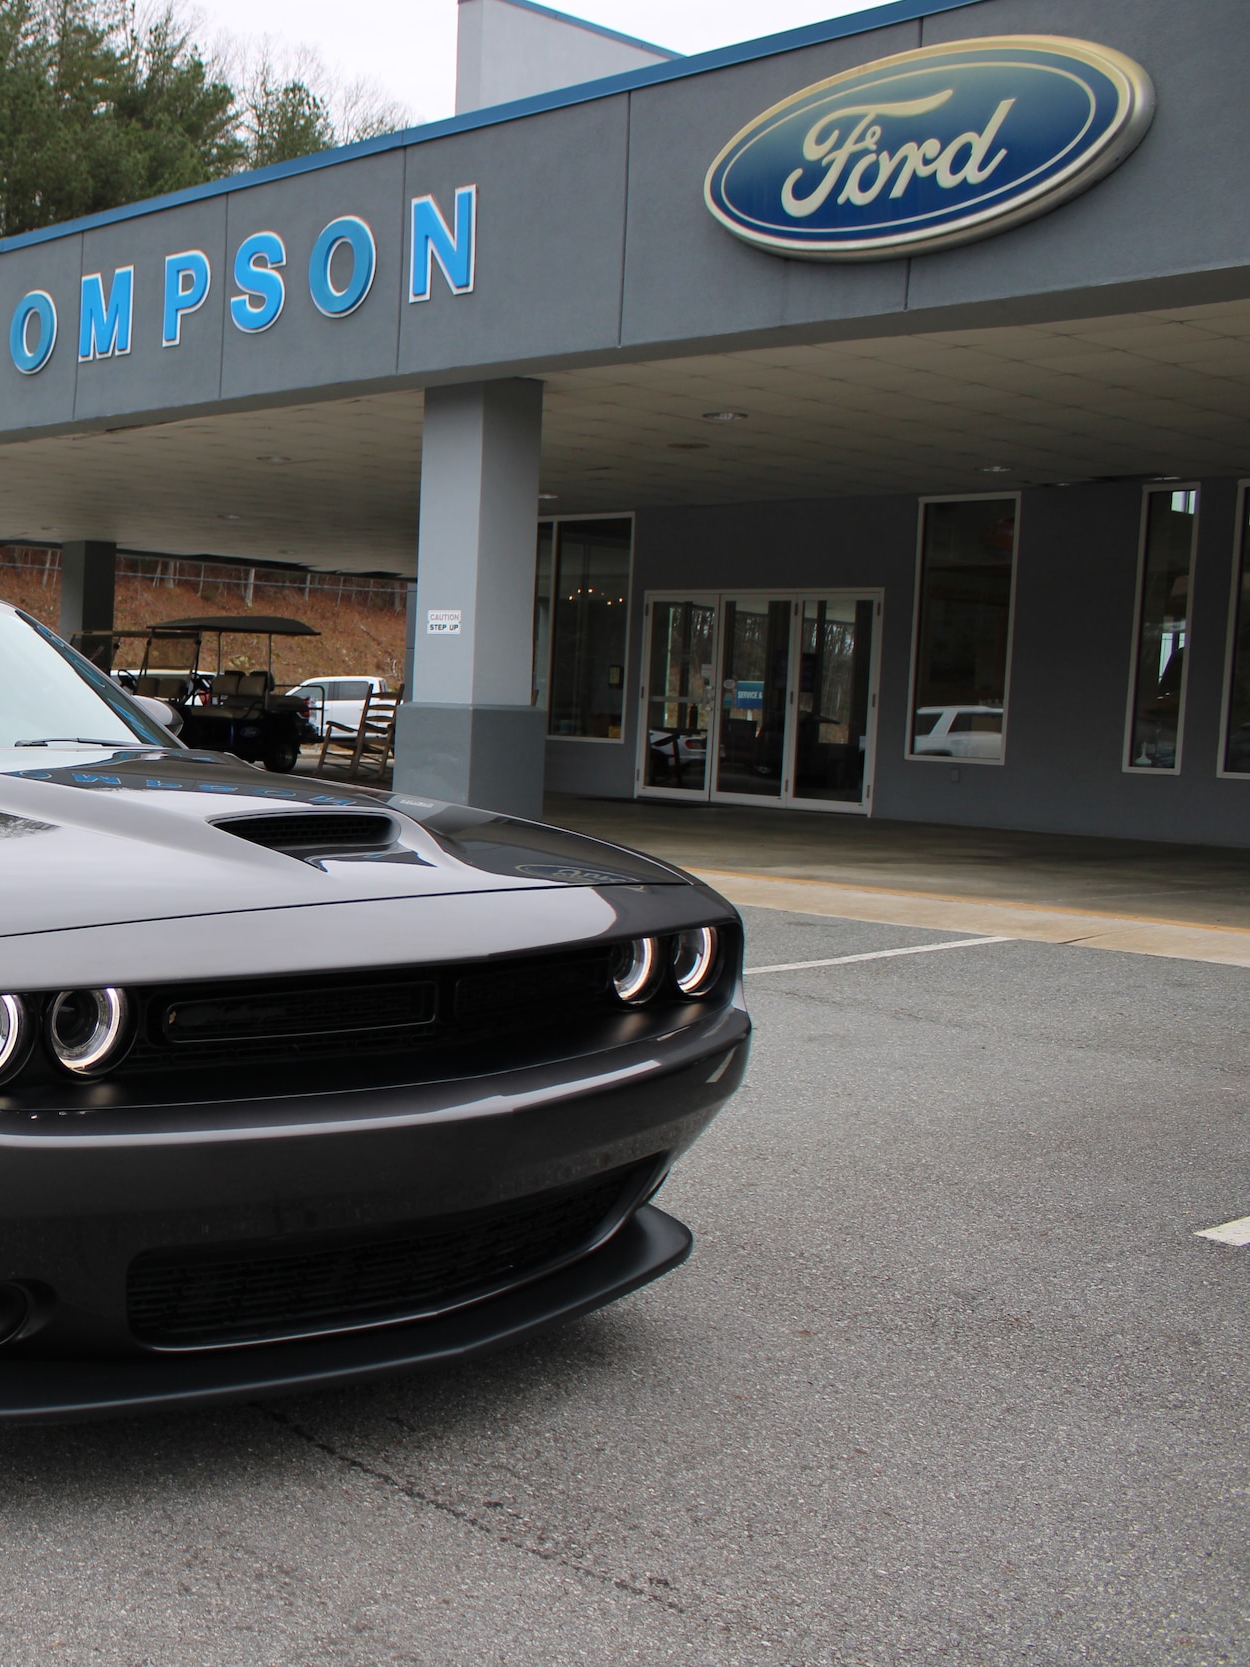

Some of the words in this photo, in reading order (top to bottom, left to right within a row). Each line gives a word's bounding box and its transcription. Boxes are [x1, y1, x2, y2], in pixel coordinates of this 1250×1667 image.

[781, 88, 1016, 218] Ford
[430, 613, 460, 622] CAUTION
[737, 690, 758, 699] SERVICE
